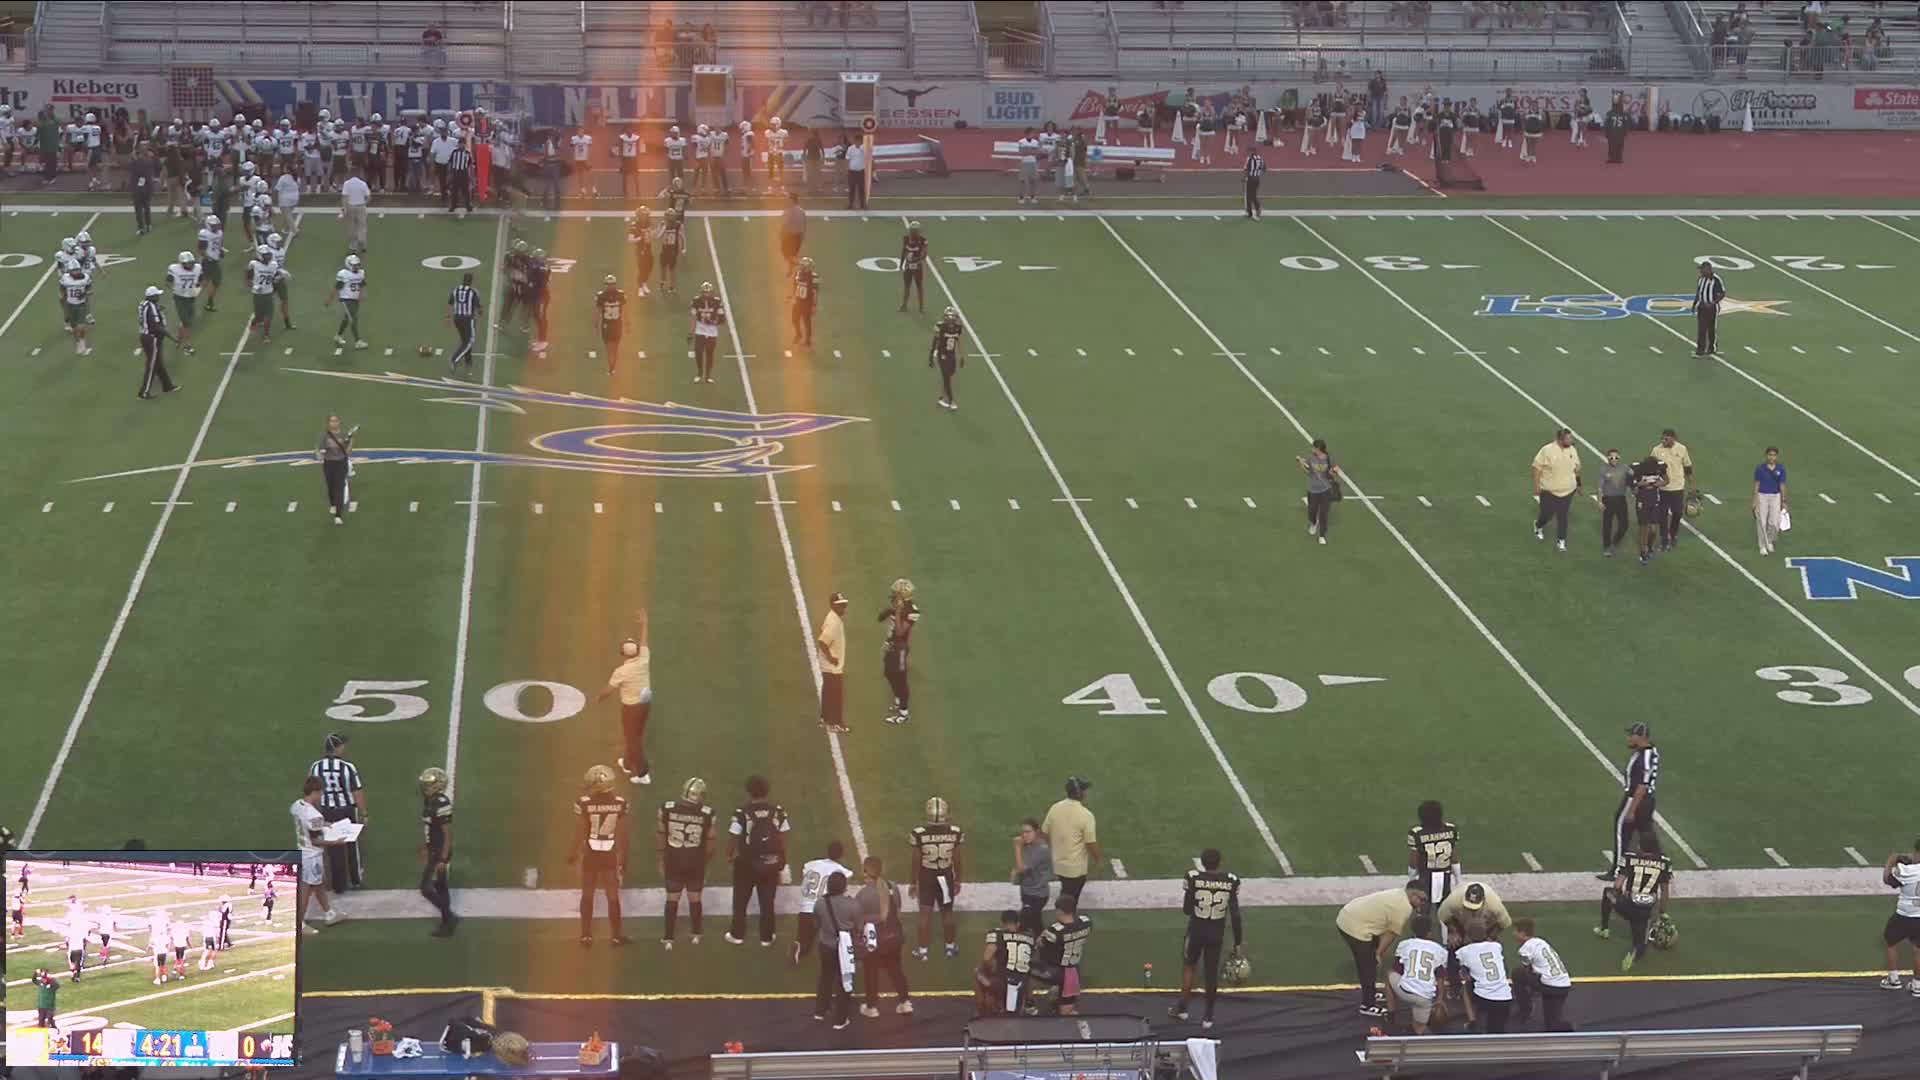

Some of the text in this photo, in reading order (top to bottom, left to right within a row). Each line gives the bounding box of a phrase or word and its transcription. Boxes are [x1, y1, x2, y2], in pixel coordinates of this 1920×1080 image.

[53, 79, 139, 98] Kleberg
[995, 91, 1034, 104] BUD
[1884, 91, 1918, 105] State
[986, 105, 1041, 119] LIGHT
[1473, 294, 1698, 320] LSC
[322, 770, 343, 792] H
[667, 821, 704, 848] 53
[1420, 831, 1454, 843] BRAHMAS
[921, 843, 955, 870] 25
[1424, 841, 1452, 869] 12
[1195, 880, 1233, 890] BRAHMAS
[1632, 866, 1661, 897] 17
[1194, 890, 1230, 920] 32
[1006, 941, 1032, 973] 16
[1406, 949, 1435, 982] 15
[1479, 951, 1500, 982] 5
[82, 1031, 102, 1054] 14
[139, 1032, 182, 1057] 4:21
[243, 1035, 256, 1058] 0
